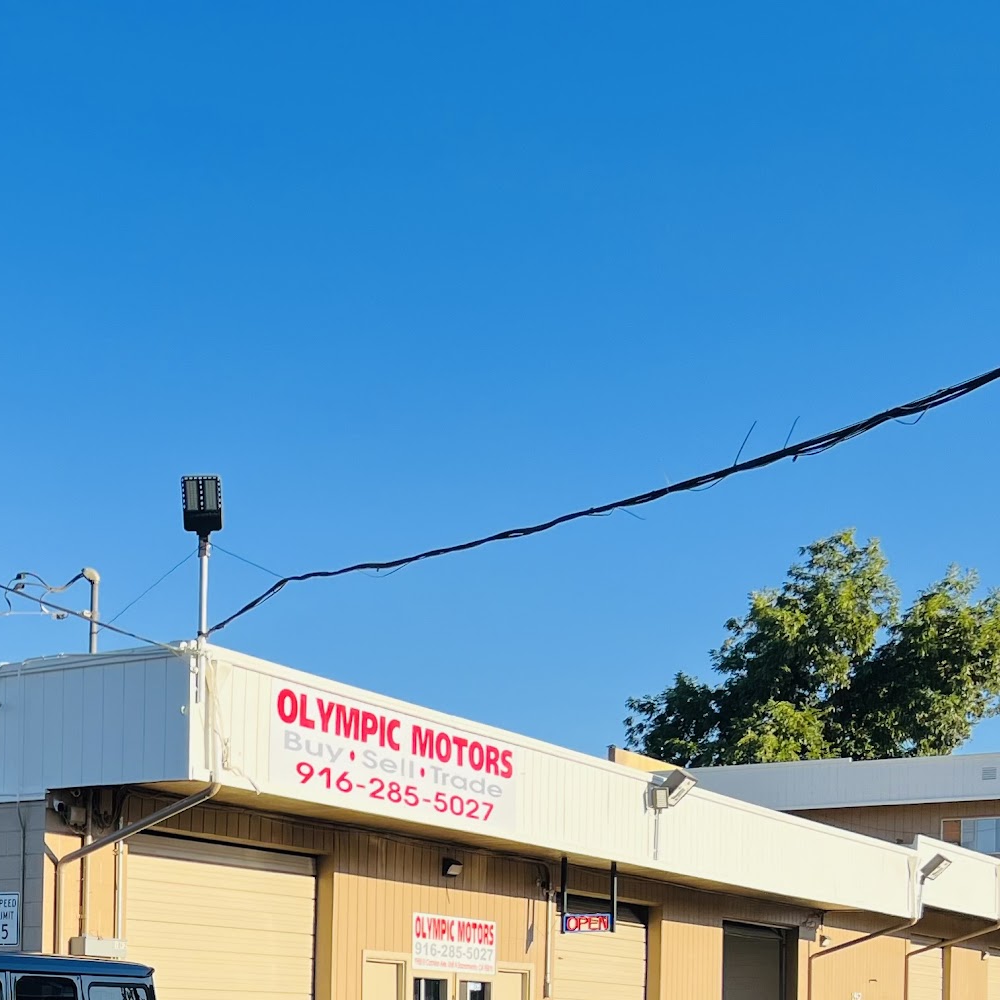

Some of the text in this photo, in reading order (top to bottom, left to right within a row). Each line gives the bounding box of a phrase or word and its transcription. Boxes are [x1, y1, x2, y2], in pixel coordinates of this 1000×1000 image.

[277, 688, 514, 779] OLYMPIC MOTORS
[284, 730, 503, 798] Buy Sell Trade
[296, 762, 494, 821] 916-285-5027
[1, 923, 8, 940] 5
[415, 916, 494, 946] OLYMPIC MOTORS
[566, 915, 609, 931] OPEN
[414, 941, 493, 961] 916-285-5027
